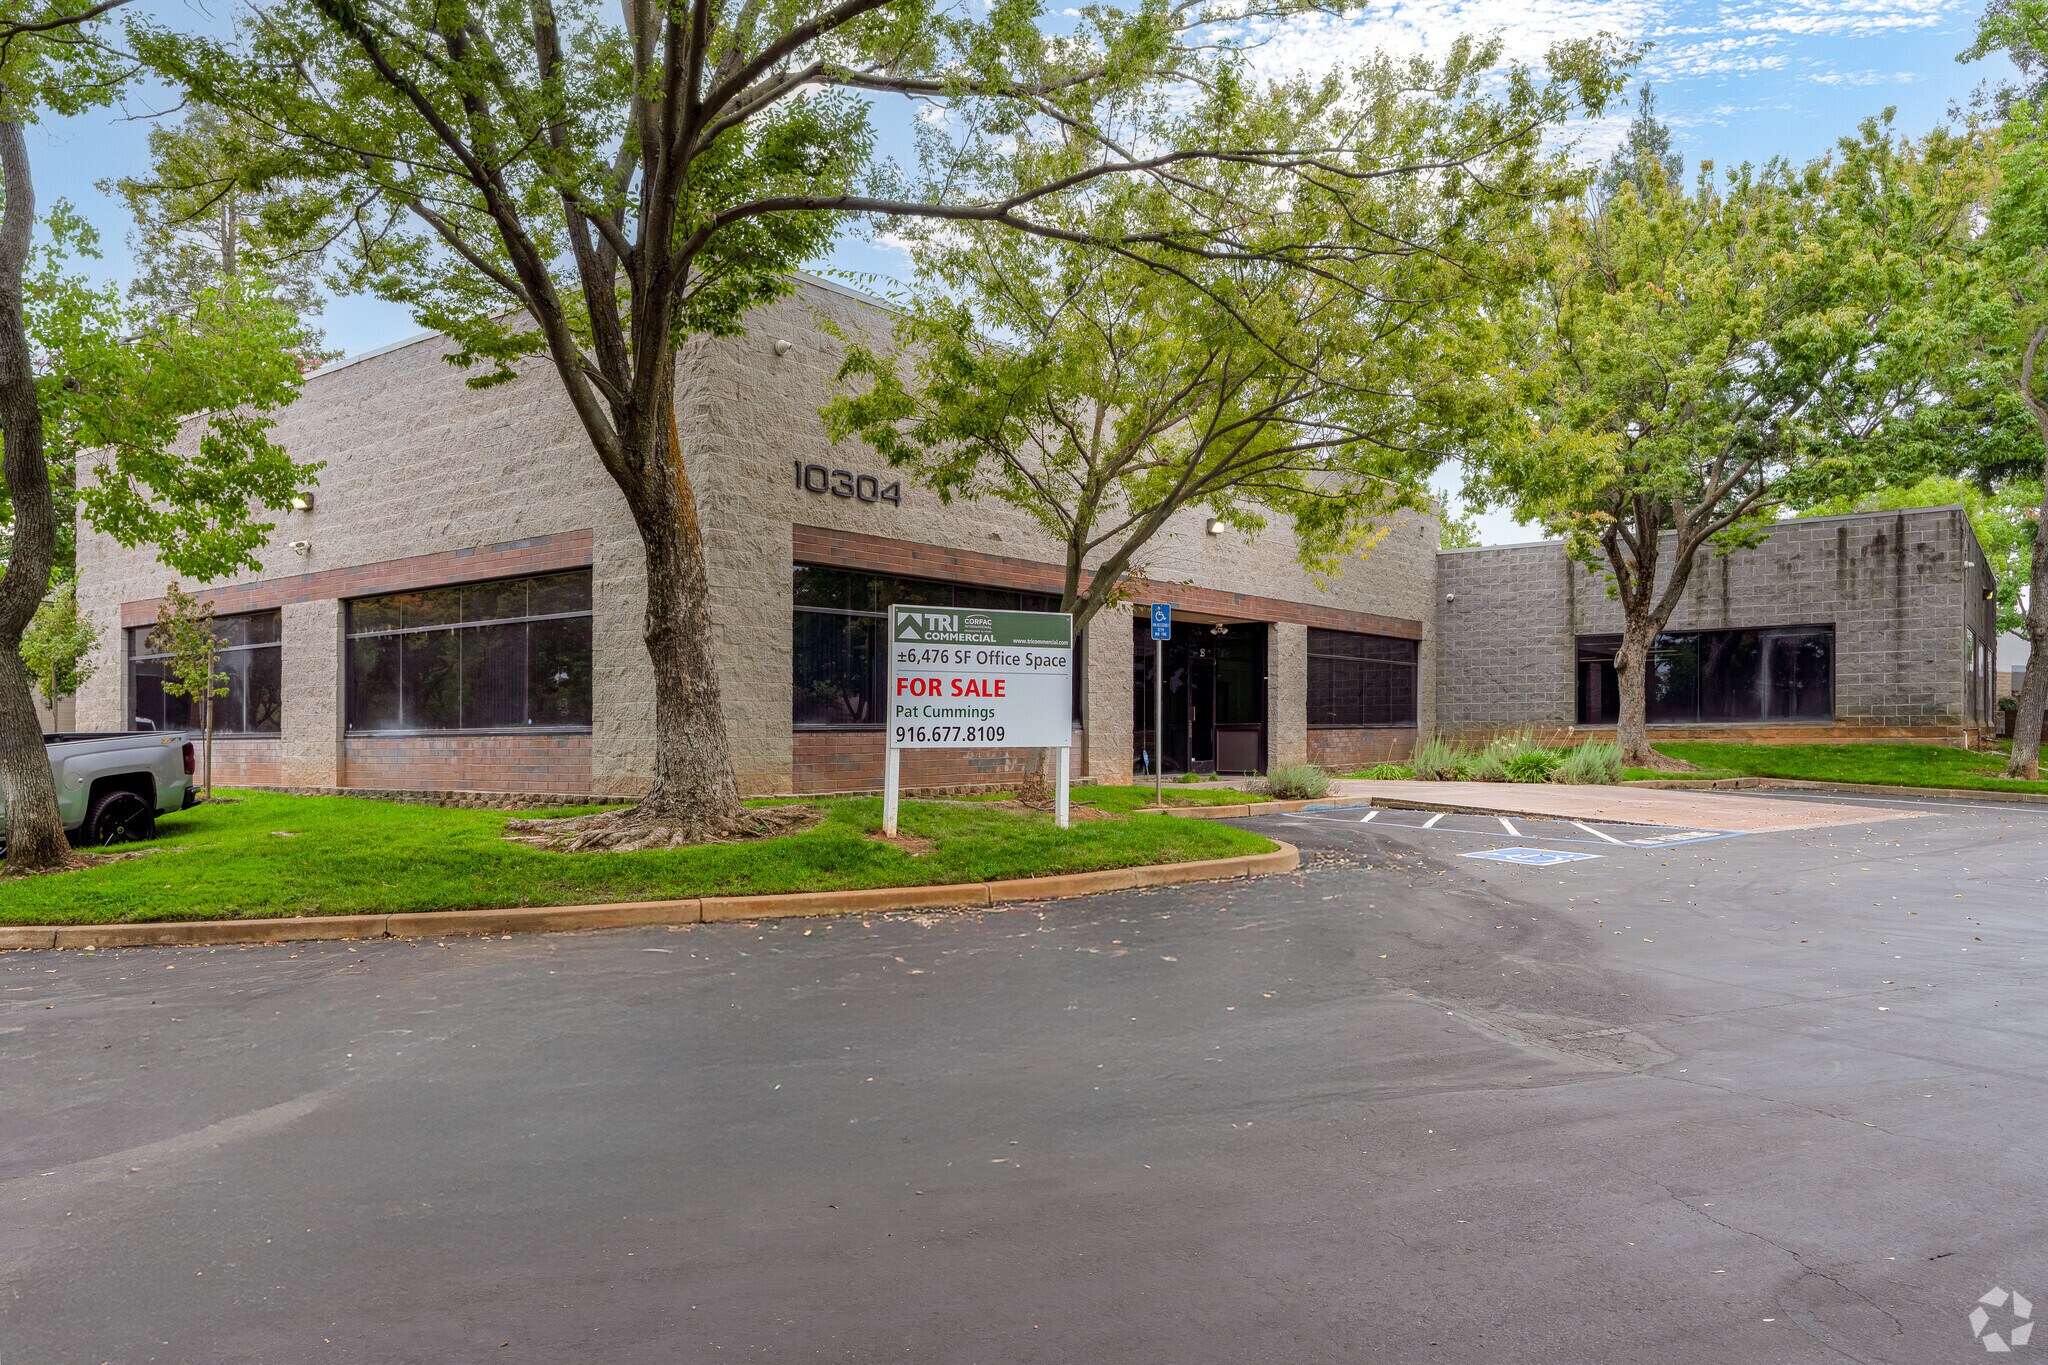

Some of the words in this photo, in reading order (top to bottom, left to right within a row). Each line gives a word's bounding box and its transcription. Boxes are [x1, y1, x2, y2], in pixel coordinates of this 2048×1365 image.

[795, 460, 901, 507] 10304
[924, 613, 958, 632] TRI
[964, 618, 992, 626] CORFAC
[924, 633, 996, 642] COMMERCIAL
[1013, 638, 1068, 646] www.tricommercial.com
[897, 648, 949, 665] ±6,476
[954, 650, 972, 664] SF
[976, 650, 1021, 666] Office
[1025, 652, 1067, 669] Space
[896, 677, 943, 697] FOR
[951, 678, 1006, 698] SALE
[896, 704, 919, 718] Pat
[923, 705, 995, 721] Cummings
[896, 726, 1005, 742] 916.677.8109
